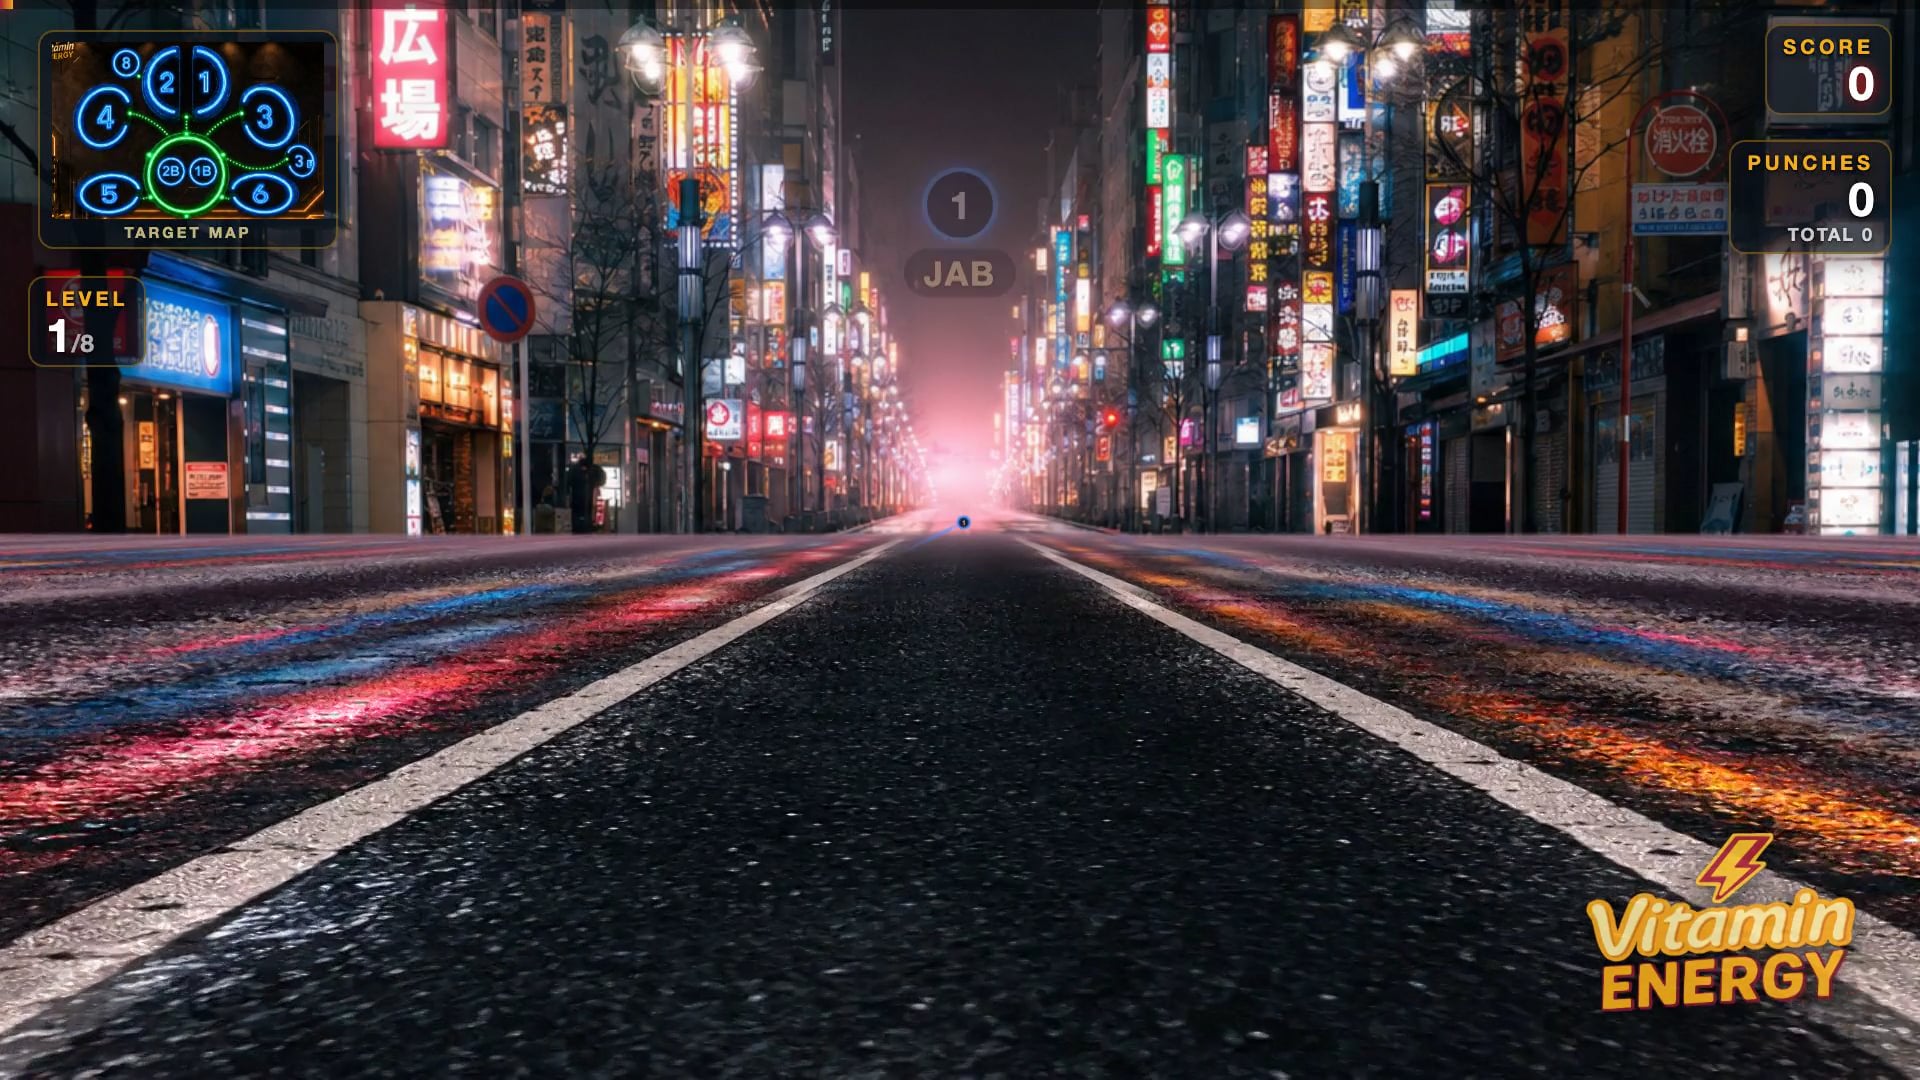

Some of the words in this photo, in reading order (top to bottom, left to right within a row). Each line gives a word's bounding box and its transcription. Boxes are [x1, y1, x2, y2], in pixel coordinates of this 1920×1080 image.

[380, 4, 441, 141] 広場
[1652, 127, 1711, 154] 消火栓
